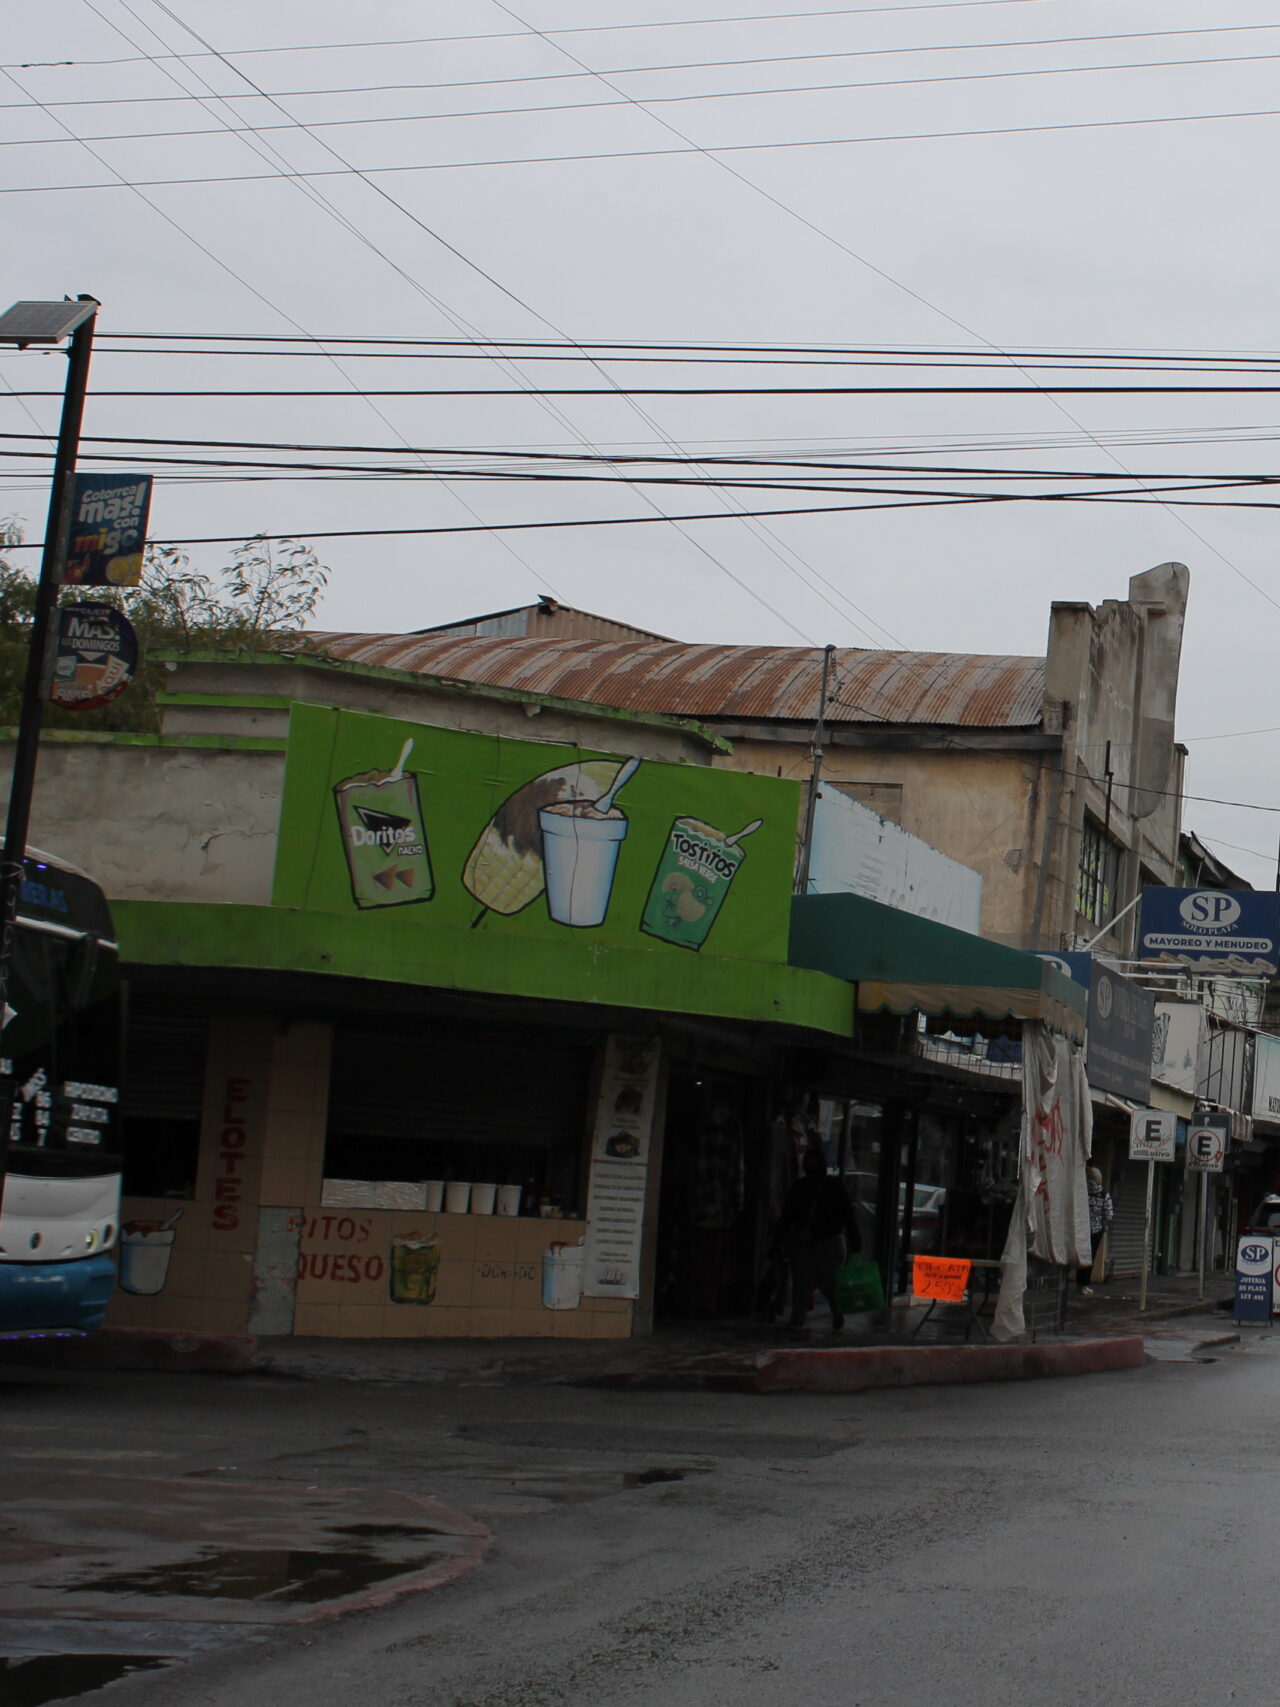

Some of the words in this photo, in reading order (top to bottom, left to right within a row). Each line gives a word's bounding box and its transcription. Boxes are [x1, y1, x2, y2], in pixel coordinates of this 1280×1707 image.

[113, 517, 139, 529] con
[72, 638, 121, 652] DOMINGOS
[351, 825, 417, 847] Doritos
[678, 855, 700, 875] SALSA
[1191, 896, 1233, 922] SP
[1181, 920, 1207, 935] SOLO
[1208, 922, 1239, 936] PLATA
[1149, 937, 1202, 948] MAYOREO
[1202, 938, 1212, 948] Y
[1214, 938, 1269, 950] MENUDEO
[1145, 1119, 1162, 1142] E
[212, 1077, 250, 1232] ELOTES
[1197, 1135, 1212, 1156] E
[1245, 1246, 1266, 1260] SP
